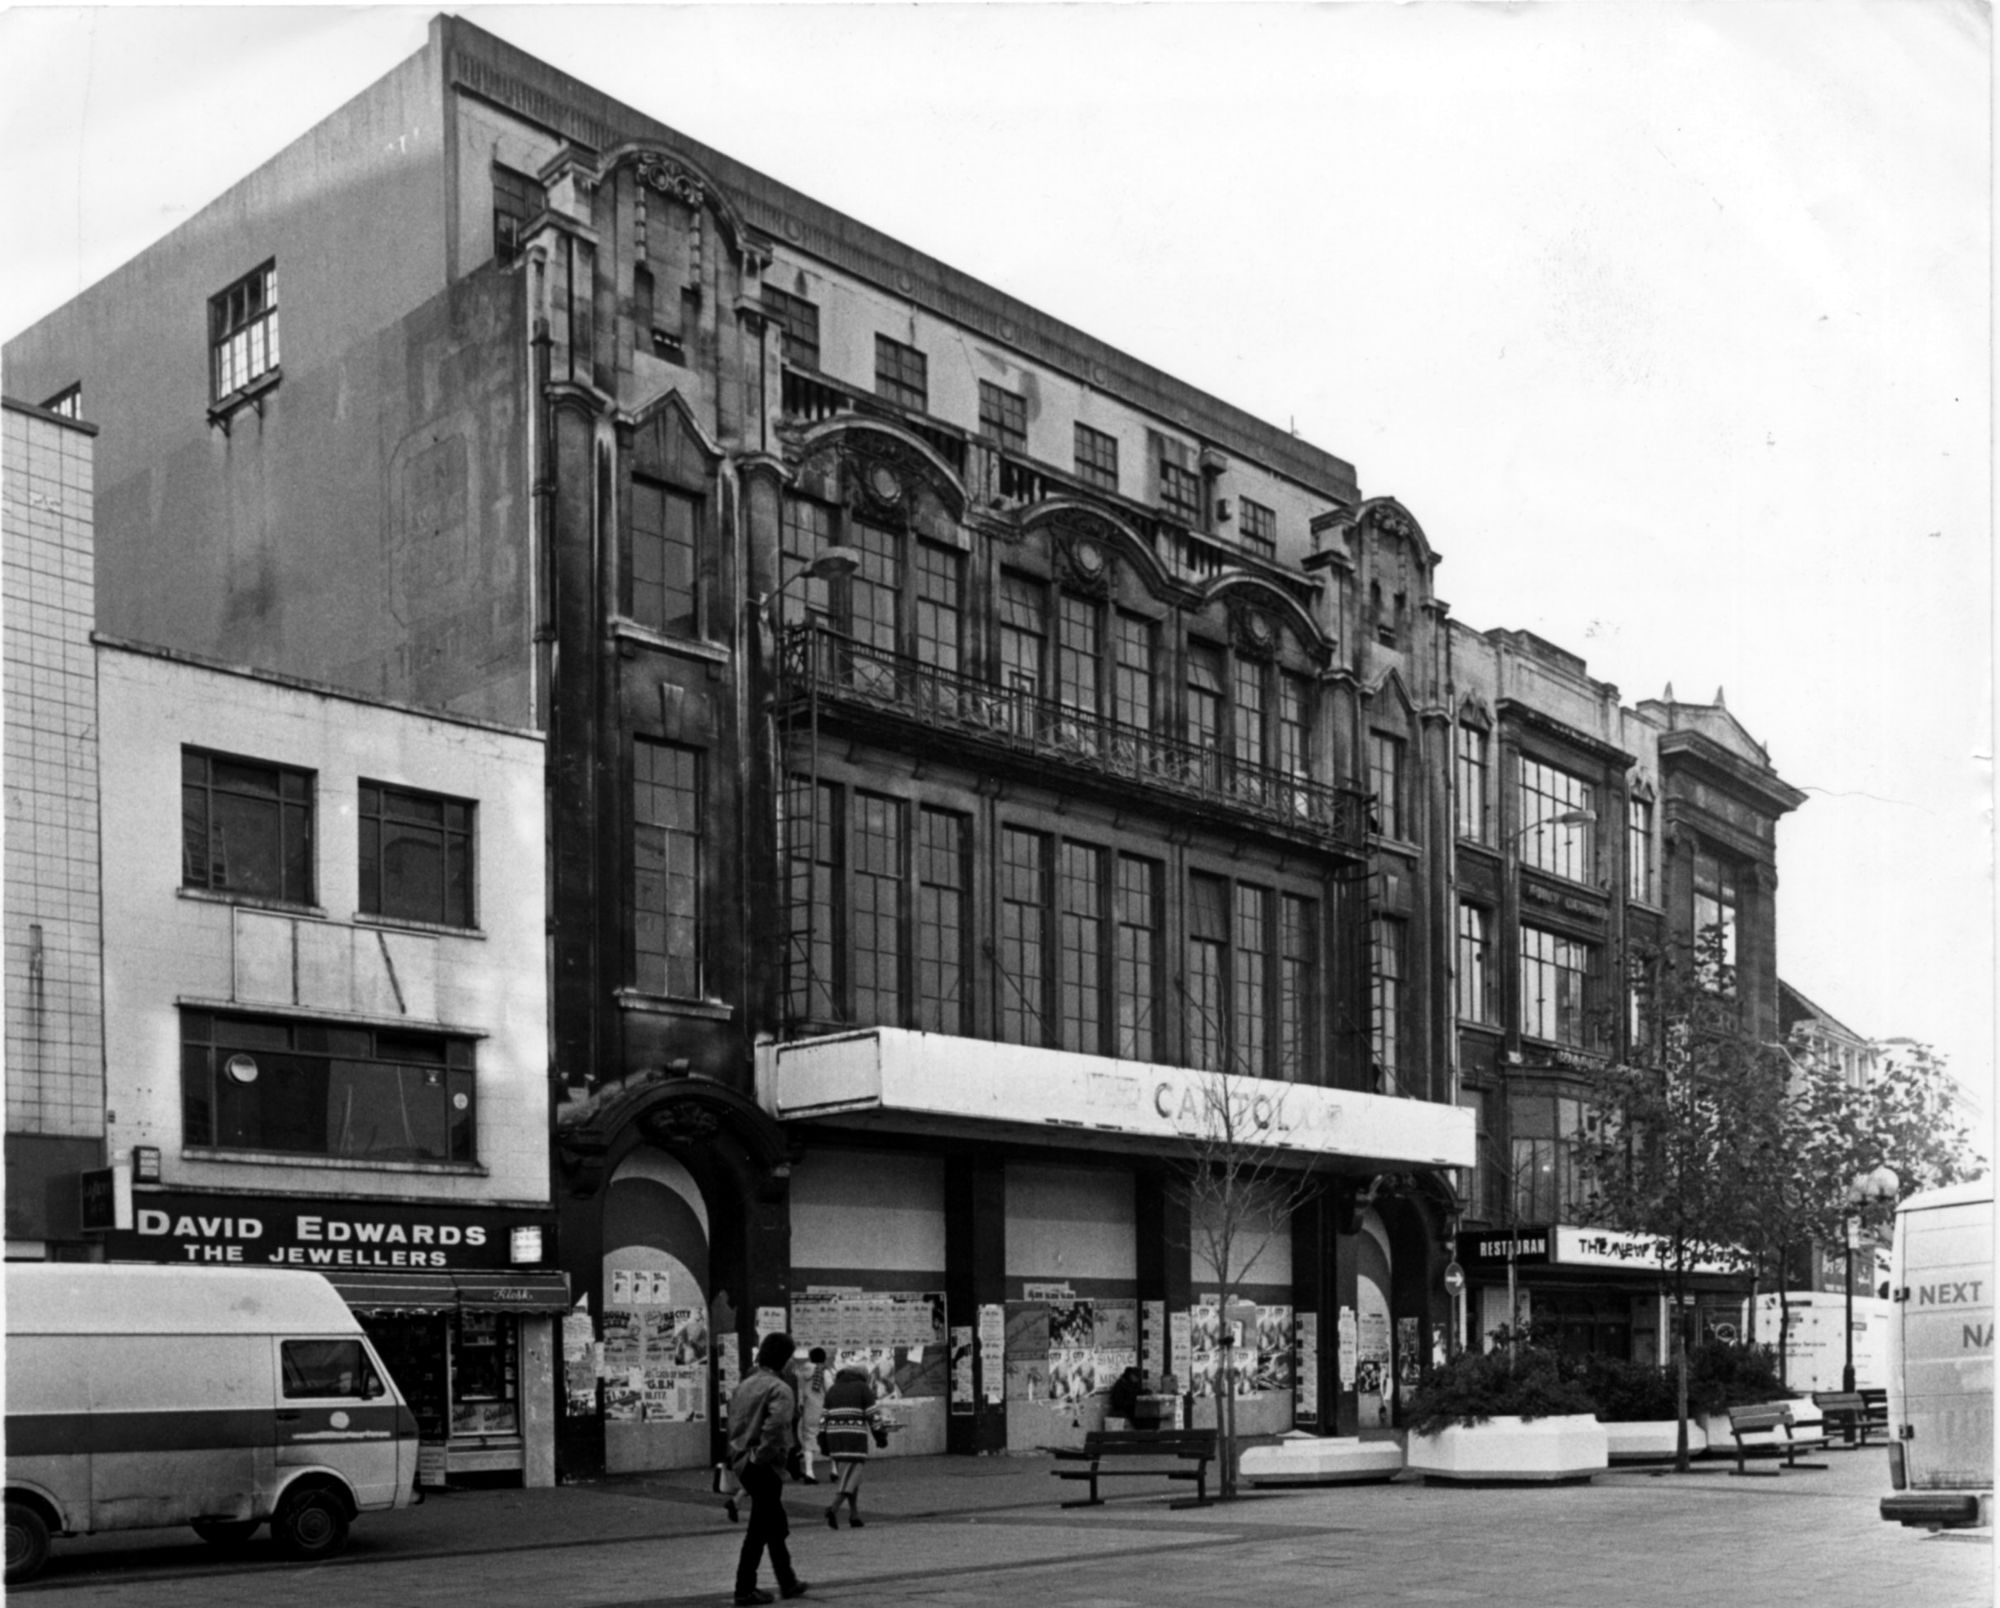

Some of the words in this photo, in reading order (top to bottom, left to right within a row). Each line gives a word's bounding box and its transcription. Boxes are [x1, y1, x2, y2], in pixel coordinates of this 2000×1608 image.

[137, 1209, 263, 1239] DAVID
[297, 1215, 488, 1246] EDWARDS
[184, 1244, 244, 1262] THE
[268, 1246, 447, 1267] JEWELLERS
[1578, 1238, 1607, 1255] THE
[1919, 1281, 1983, 1306] NEXT
[674, 1310, 691, 1319] CITY
[1097, 1352, 1134, 1366] SIMPLE
